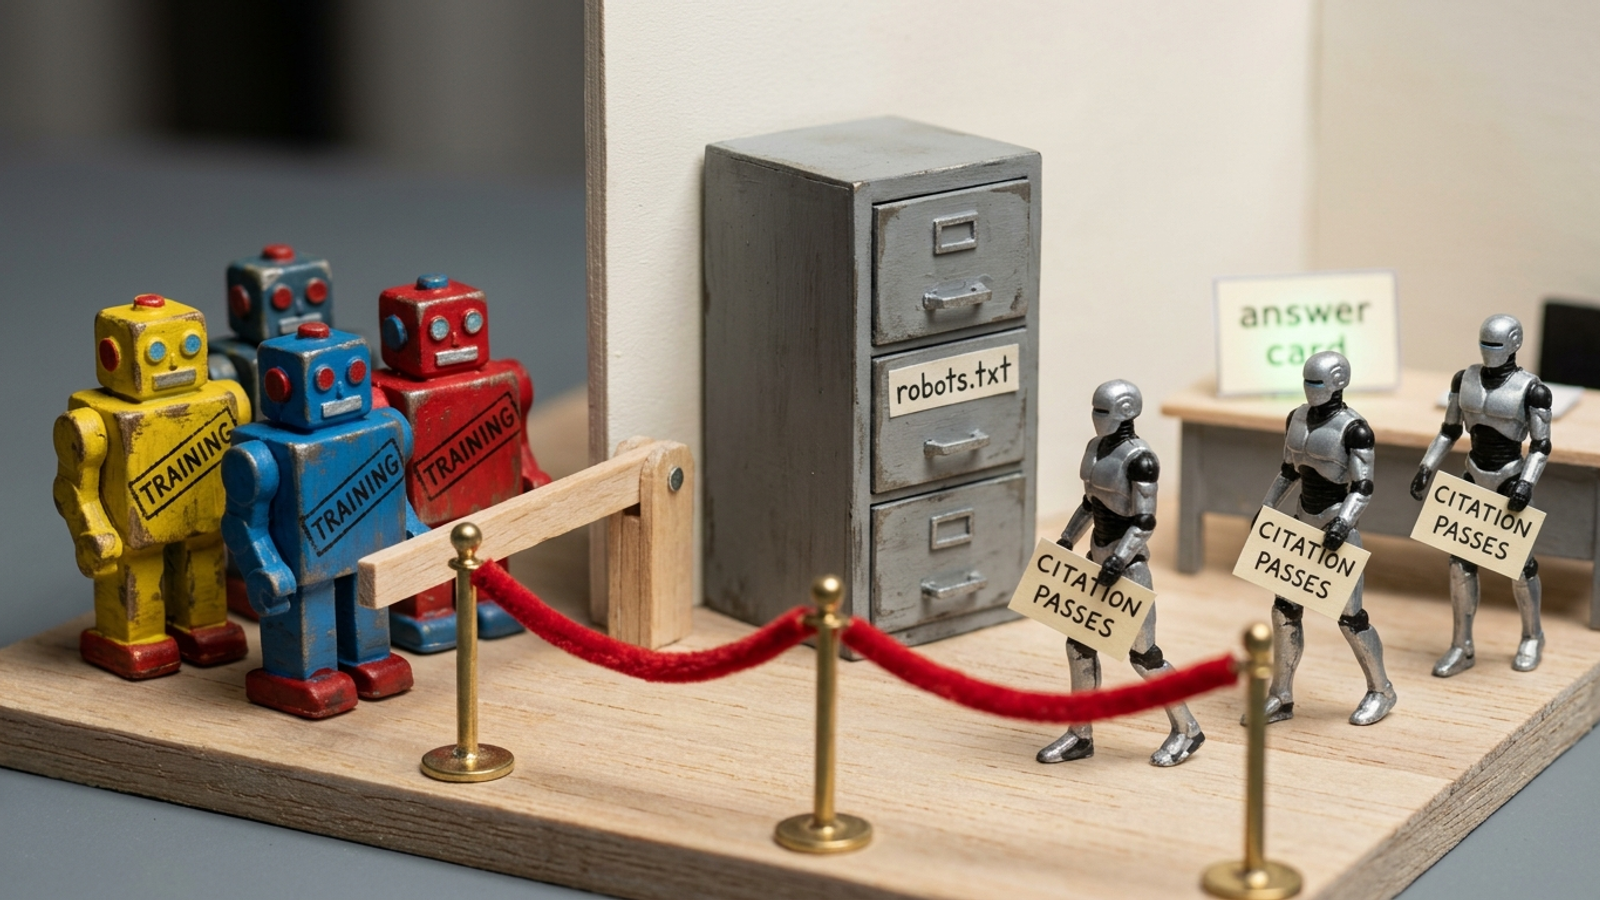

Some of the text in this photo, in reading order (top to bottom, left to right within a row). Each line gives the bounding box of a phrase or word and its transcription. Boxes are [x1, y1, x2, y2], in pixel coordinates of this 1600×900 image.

[1240, 302, 1371, 328] answer
[896, 355, 1012, 404] robots.txt
[139, 422, 232, 505] TRAINING
[423, 406, 514, 486] TRAINING
[311, 454, 399, 540] TRAINING
[1434, 485, 1532, 538] CITATION
[1259, 521, 1356, 577] CITATION
[1433, 515, 1509, 560] PASSES
[1037, 554, 1142, 617] CITATION
[1254, 551, 1331, 599] PASSES
[1033, 585, 1115, 637] PASSES
